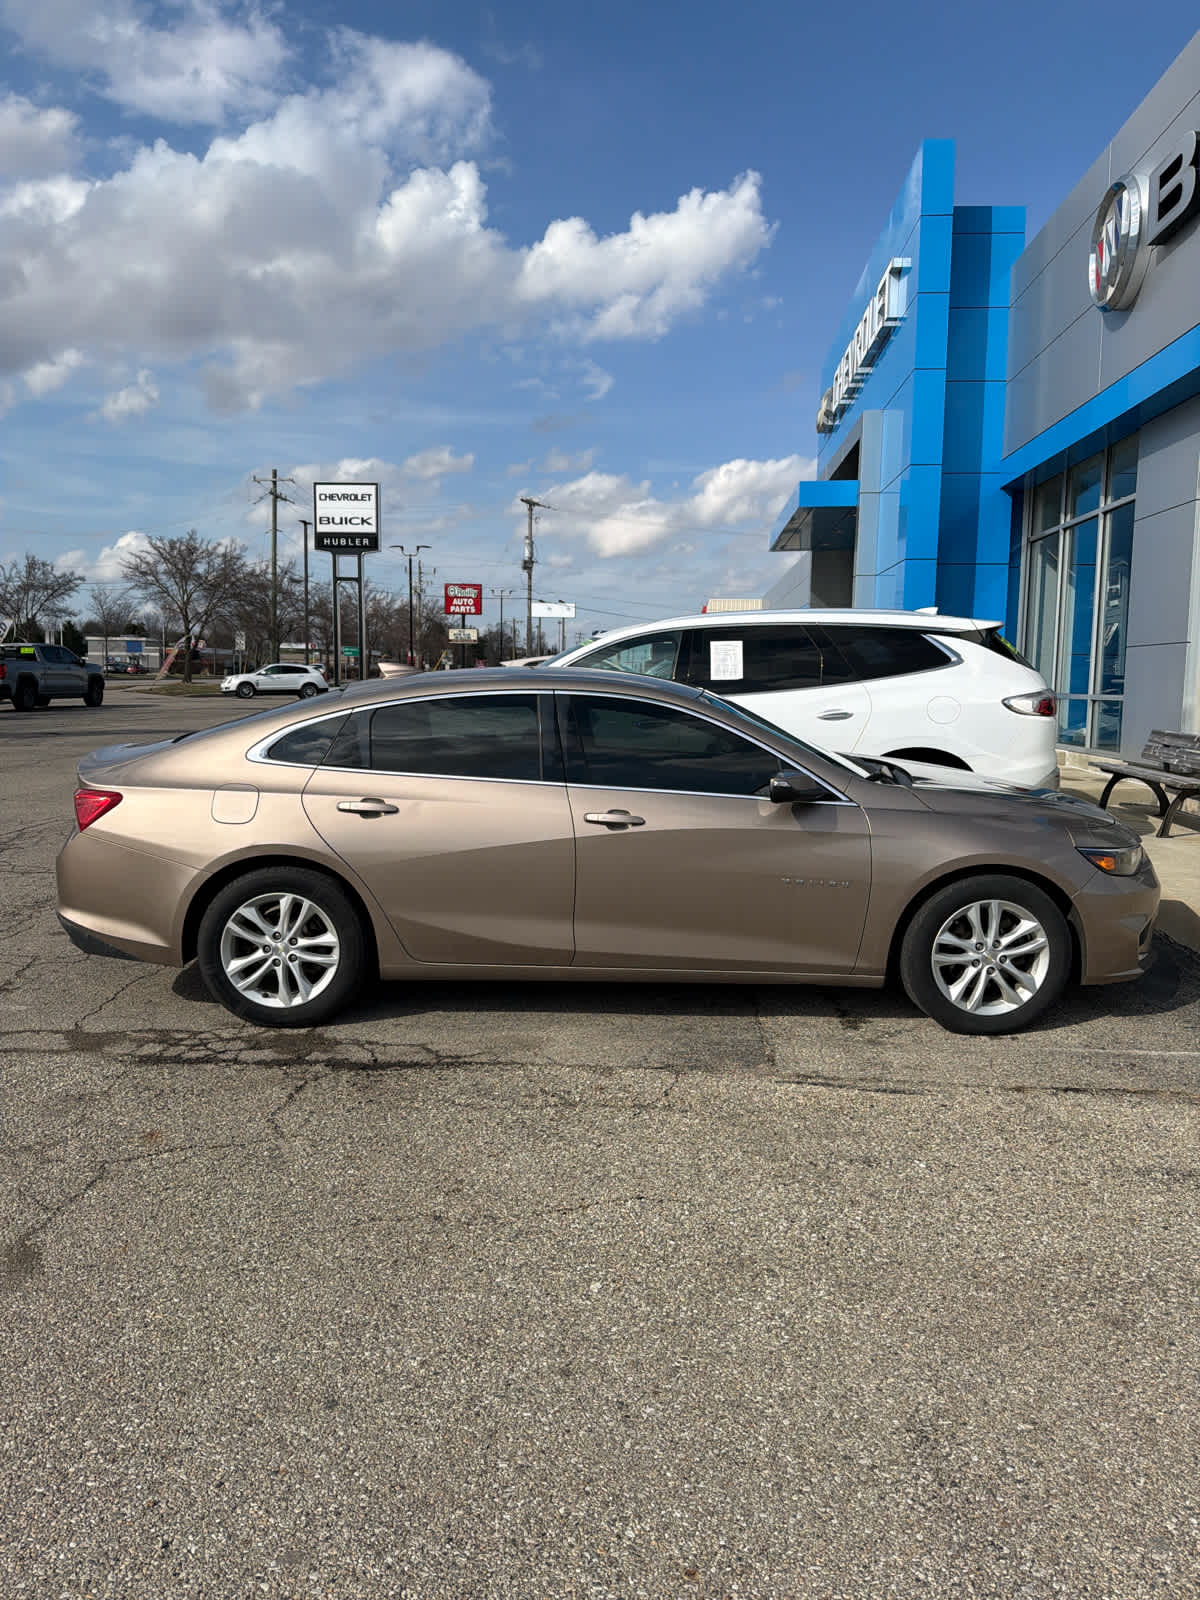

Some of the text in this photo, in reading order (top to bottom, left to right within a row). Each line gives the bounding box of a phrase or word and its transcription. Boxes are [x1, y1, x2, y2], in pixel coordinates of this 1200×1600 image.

[319, 493, 372, 501] CHEVROLET
[319, 516, 373, 525] BUICK
[323, 537, 369, 546] HUBLER
